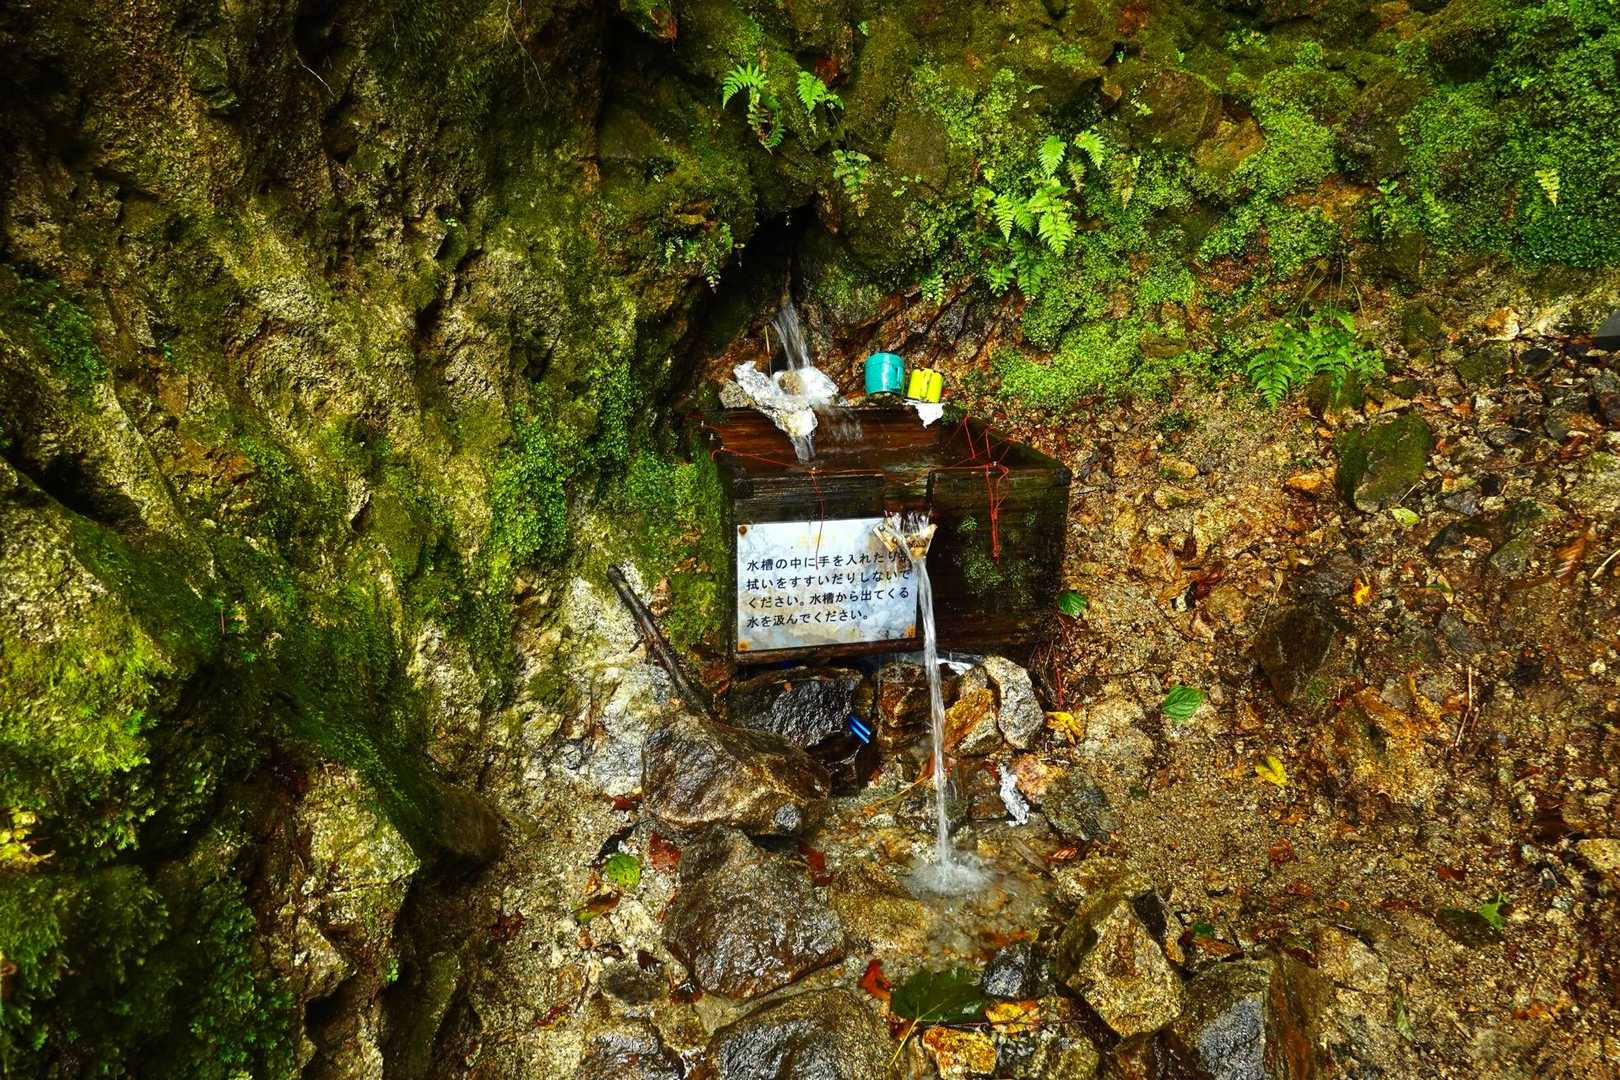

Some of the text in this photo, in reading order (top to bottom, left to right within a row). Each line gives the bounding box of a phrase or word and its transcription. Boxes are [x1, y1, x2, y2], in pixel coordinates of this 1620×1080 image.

[747, 570, 911, 590] 拭いをすすいだりしないで
[749, 587, 909, 608] ください。水槽から出てくる
[747, 610, 868, 628] 水を汲んでください。
